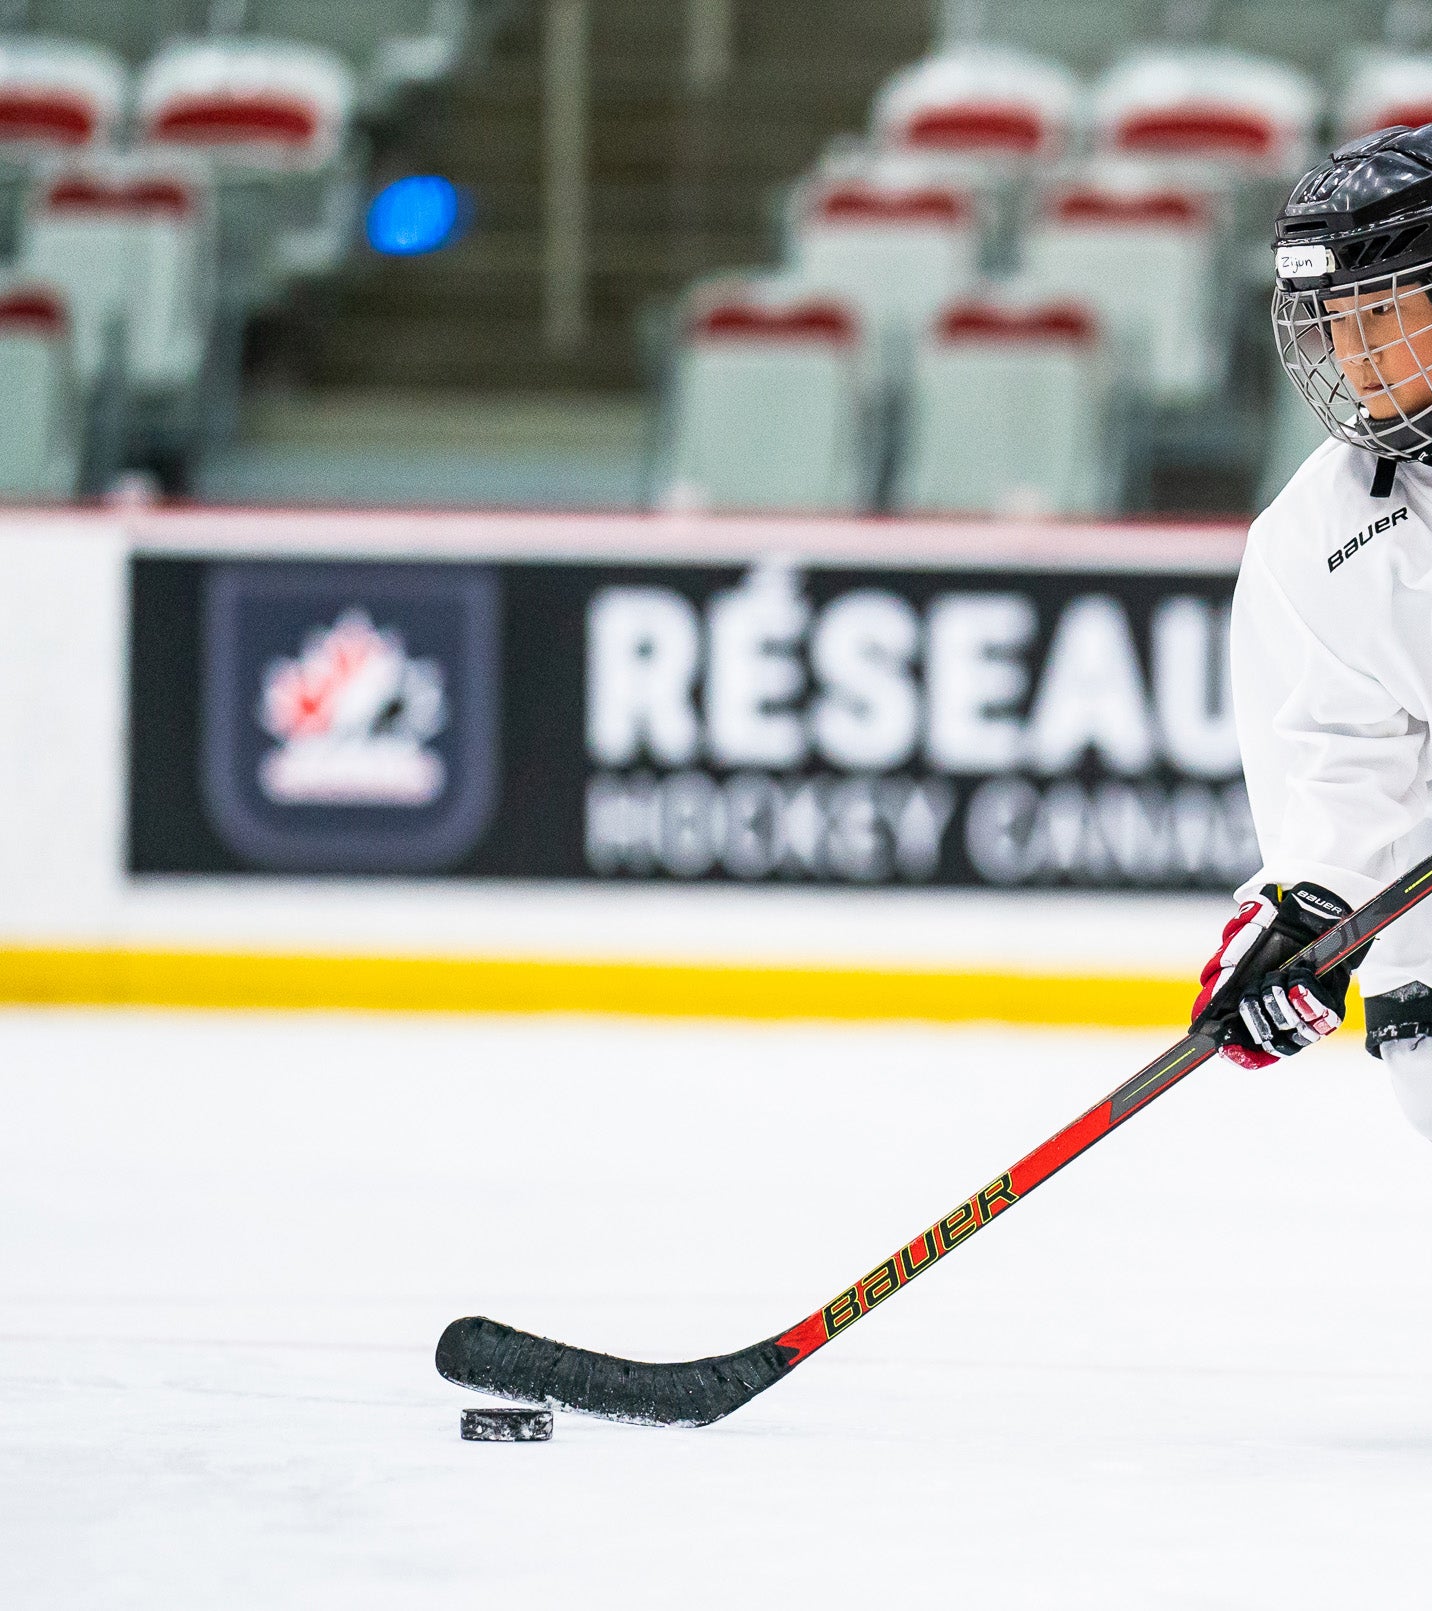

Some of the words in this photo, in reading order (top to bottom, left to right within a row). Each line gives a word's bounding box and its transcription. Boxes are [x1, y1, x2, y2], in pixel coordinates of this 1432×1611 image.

[1281, 256, 1313, 274] Zijun
[587, 552, 1243, 778] RÉSEAU
[586, 770, 955, 881] HOCKEY
